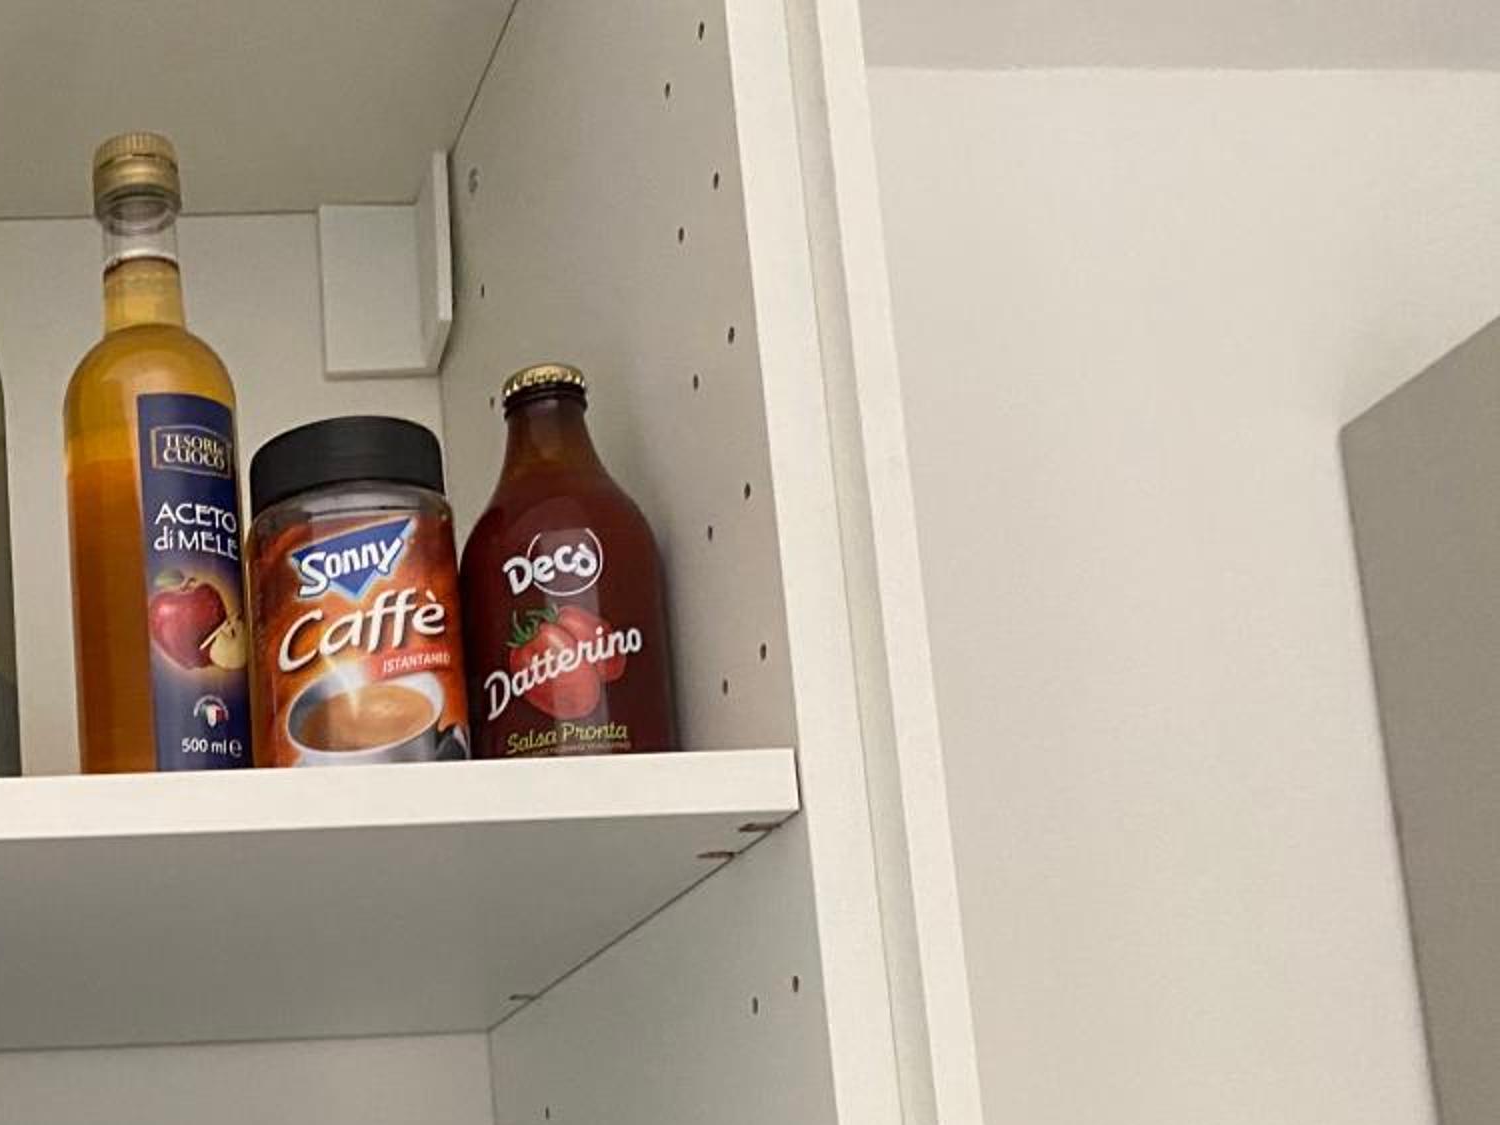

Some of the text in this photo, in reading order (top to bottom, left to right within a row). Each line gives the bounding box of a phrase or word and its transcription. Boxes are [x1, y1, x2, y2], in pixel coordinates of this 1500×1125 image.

[163, 447, 225, 470] CUOCO
[154, 503, 237, 533] ACETO
[154, 526, 238, 561] di MELE
[298, 537, 403, 598] Sonny
[503, 543, 597, 595] Decò
[278, 588, 445, 672] Caffè
[484, 625, 642, 721] Datterino
[181, 737, 208, 753] 500
[211, 739, 227, 755] ml
[507, 729, 556, 753] Salsa
[562, 721, 627, 742] Pronta
